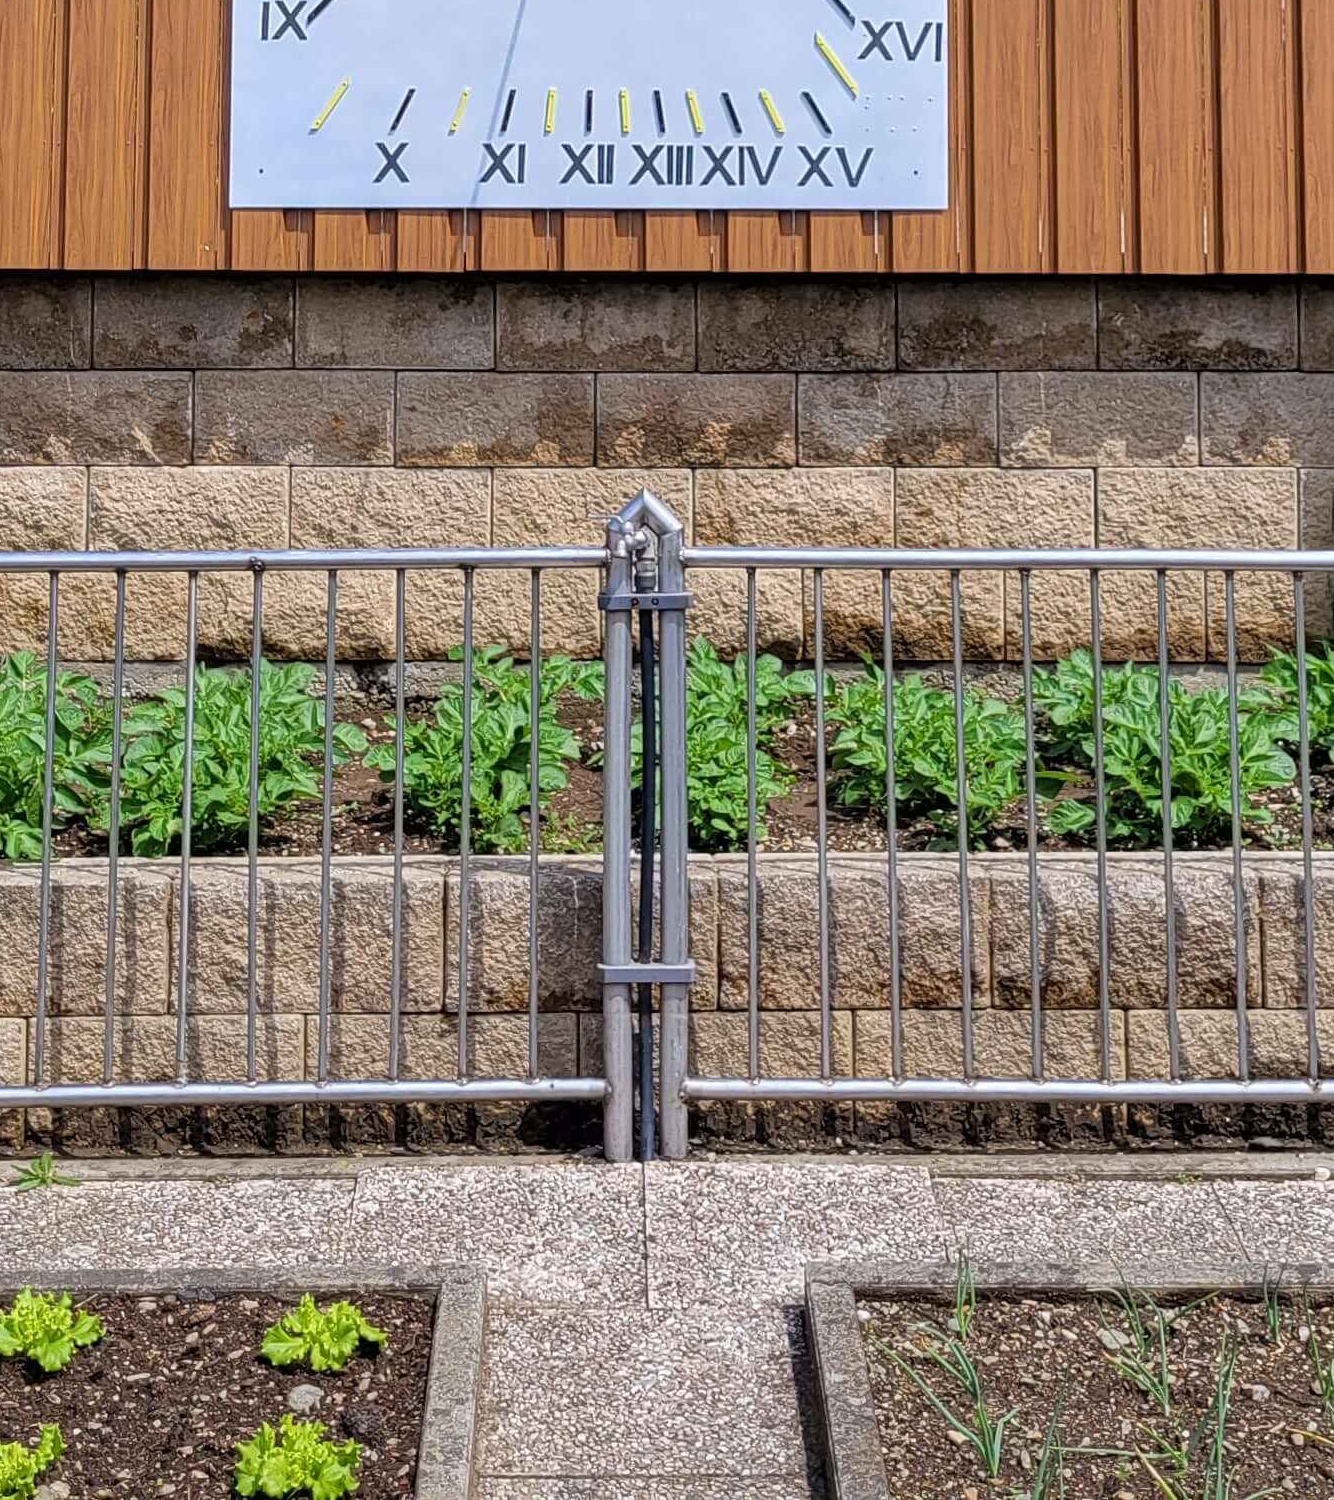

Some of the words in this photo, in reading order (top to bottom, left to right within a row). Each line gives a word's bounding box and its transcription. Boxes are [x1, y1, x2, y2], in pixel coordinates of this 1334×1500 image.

[261, 0, 307, 40] IX
[857, 20, 943, 62] XVI
[373, 142, 410, 183] X
[479, 143, 527, 184] XI
[559, 144, 615, 184] XII
[629, 145, 694, 186] XIII
[700, 145, 783, 186] XIV
[797, 146, 874, 187] XV
